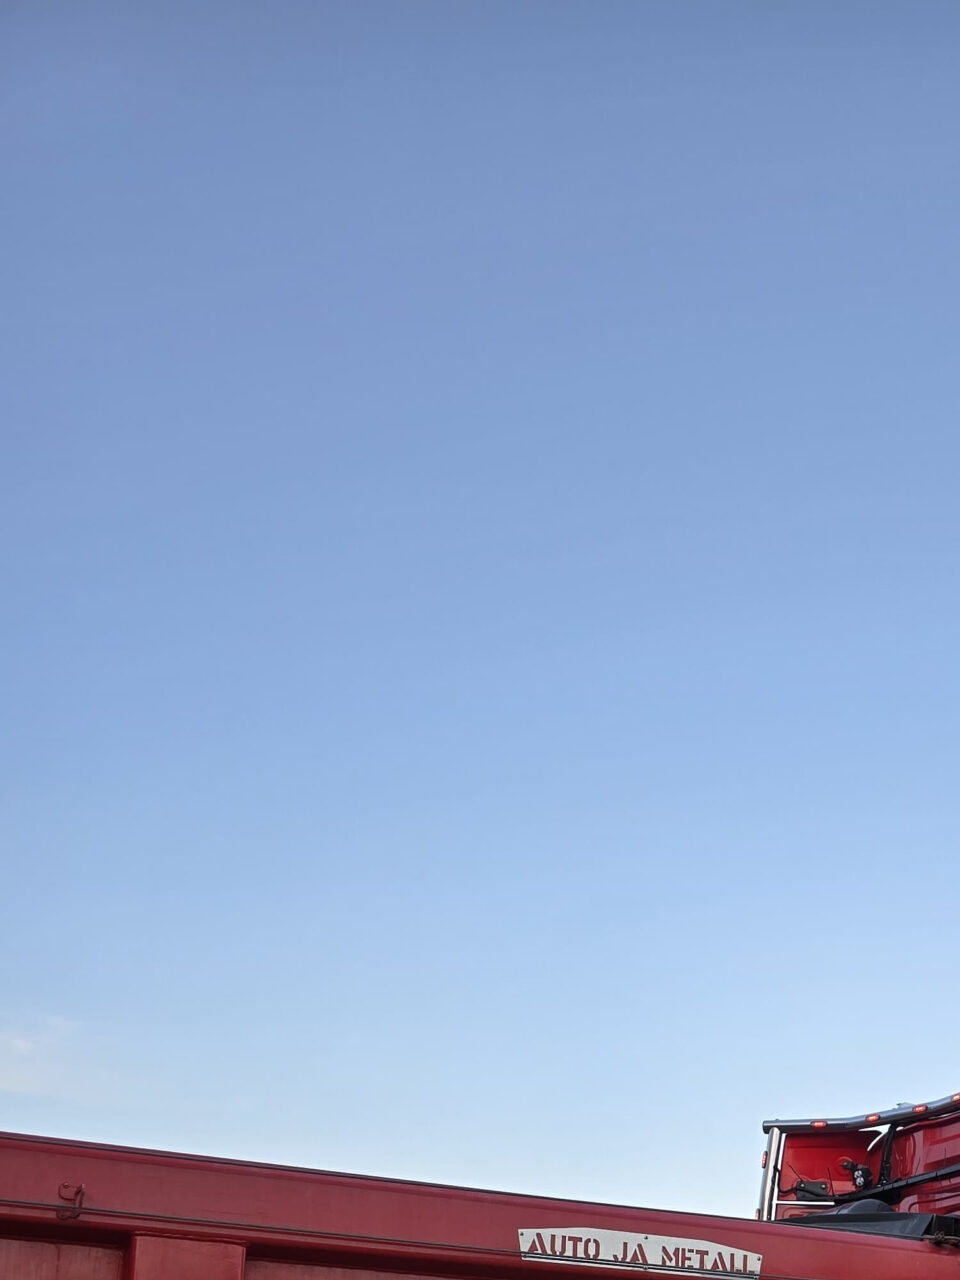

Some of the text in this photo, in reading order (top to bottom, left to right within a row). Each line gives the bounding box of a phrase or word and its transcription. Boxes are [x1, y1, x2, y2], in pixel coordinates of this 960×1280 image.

[527, 1232, 755, 1274] AUTO JA METALL
